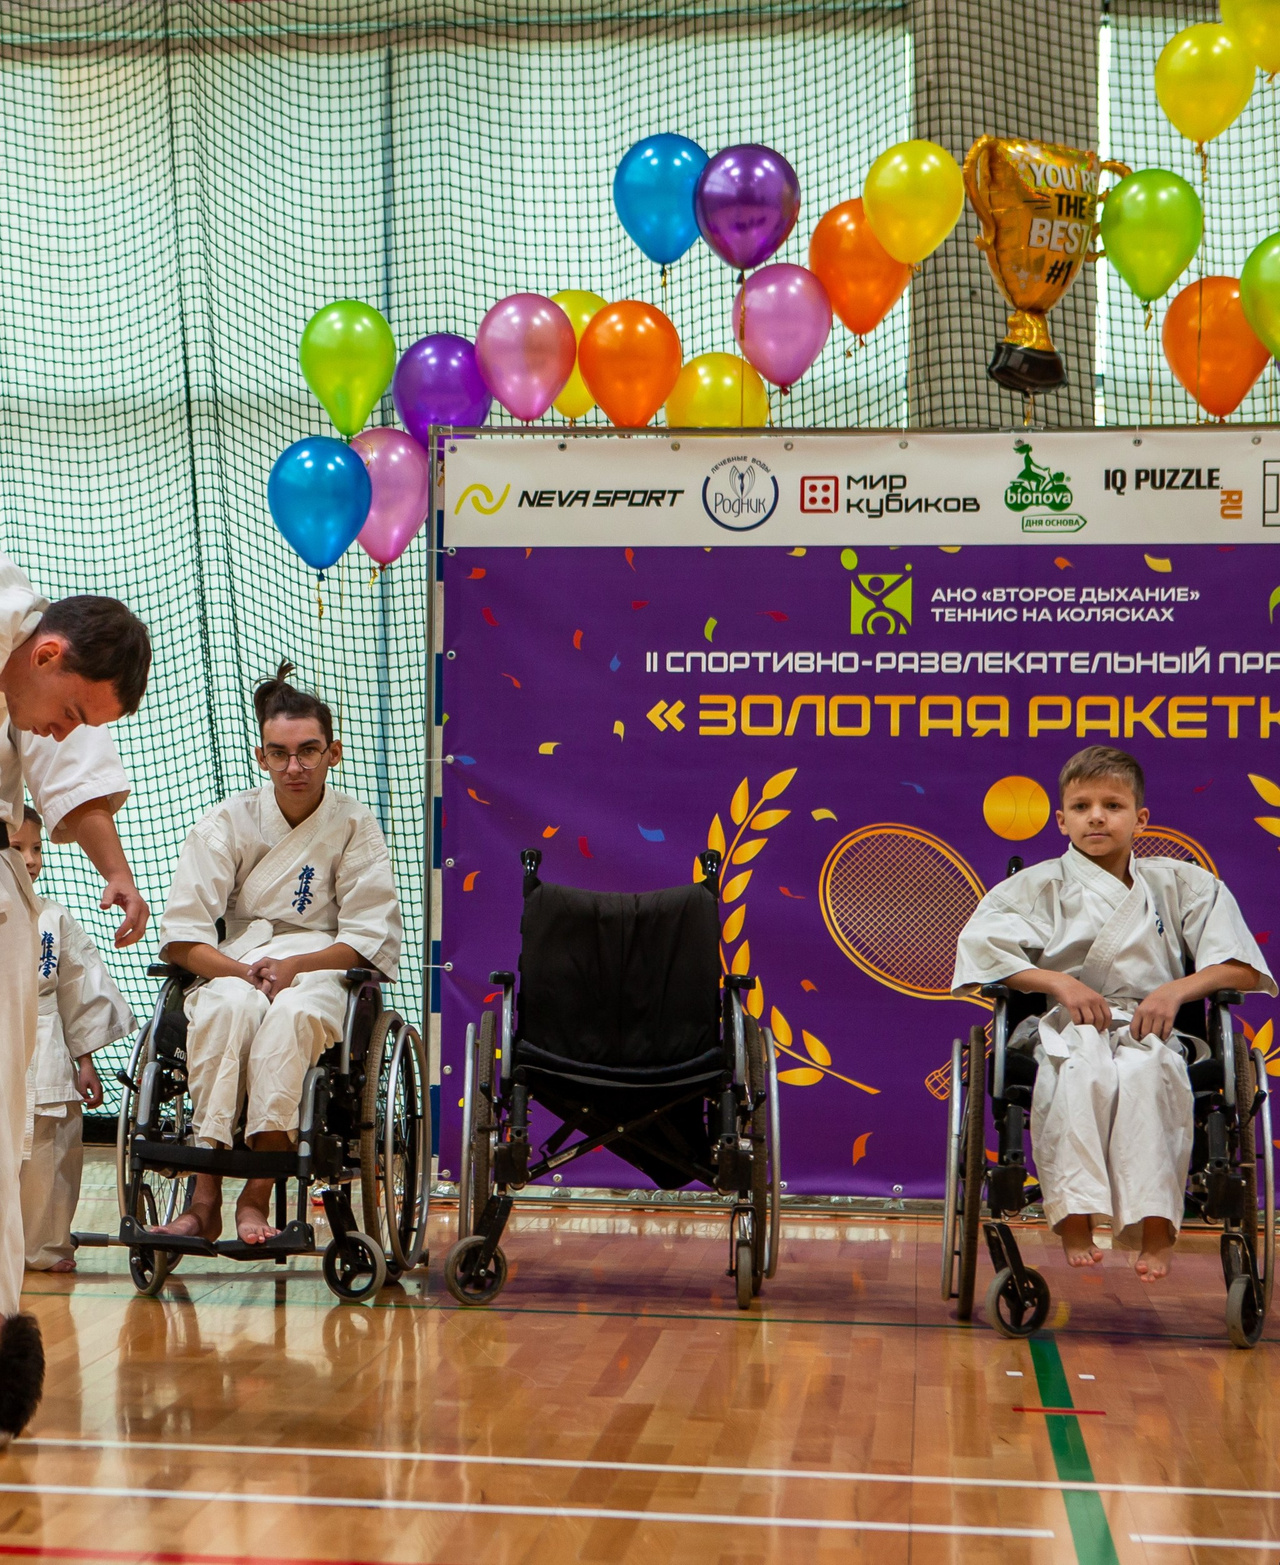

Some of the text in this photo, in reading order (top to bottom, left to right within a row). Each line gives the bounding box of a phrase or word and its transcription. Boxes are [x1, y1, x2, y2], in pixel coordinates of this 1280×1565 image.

[1055, 193, 1087, 219] THE
[1029, 218, 1090, 254] BEST
[1045, 260, 1073, 287] #1
[1104, 469, 1127, 496] IQ
[518, 489, 685, 508] NEVA SPORT
[1006, 488, 1072, 504] bionova
[1025, 519, 1080, 527] ДНЯ ОСНОВА
[931, 588, 1200, 604] АНО «ВТОРОЕ ДЫХАНИЕ»
[931, 608, 1174, 622] ТЕННИС НА КОЛЯСКАХ
[666, 646, 1210, 674] СПОРТИВНО-РАЗВЛЕКАТЕЛЬНЫЙ
